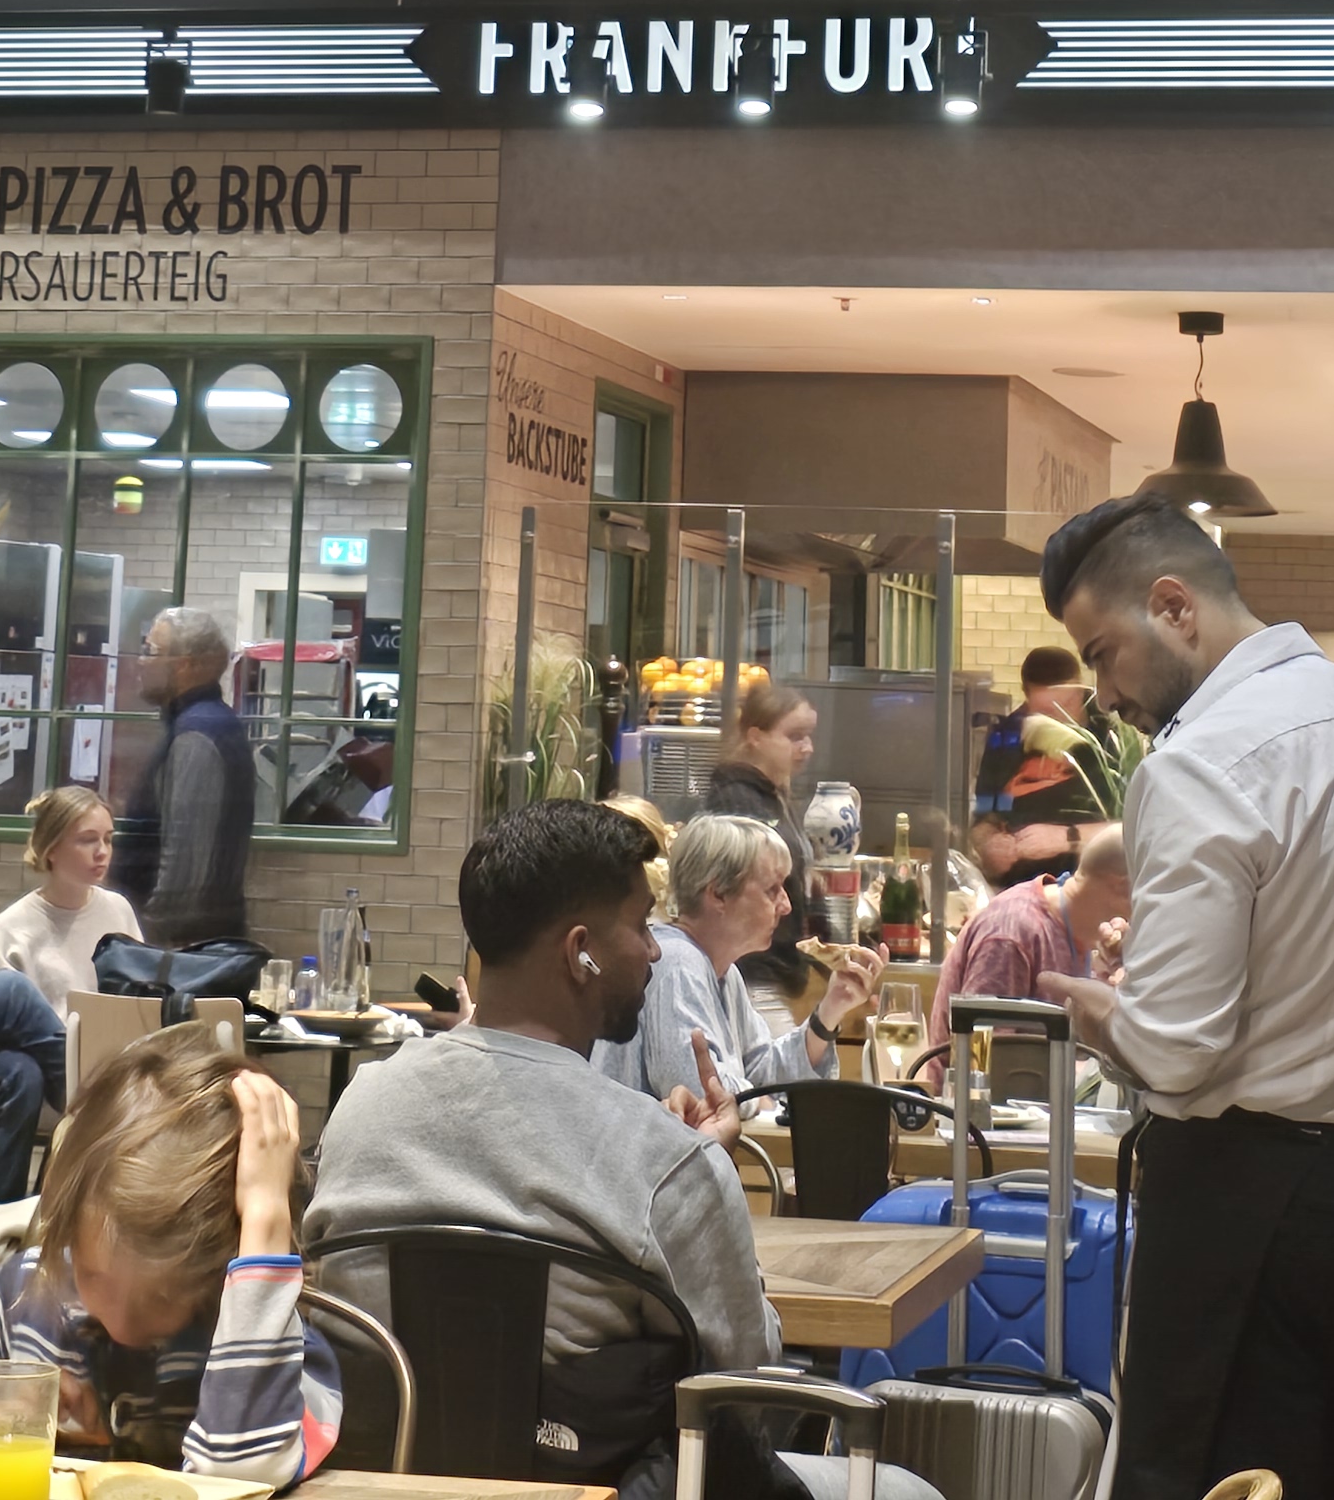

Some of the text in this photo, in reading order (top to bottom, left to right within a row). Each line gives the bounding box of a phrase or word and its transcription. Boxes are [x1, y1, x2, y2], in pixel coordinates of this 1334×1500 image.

[479, 17, 978, 95] FRANKFUR
[161, 165, 202, 236] &
[217, 163, 364, 235] BROT
[507, 412, 588, 486] BACKSTUBE
